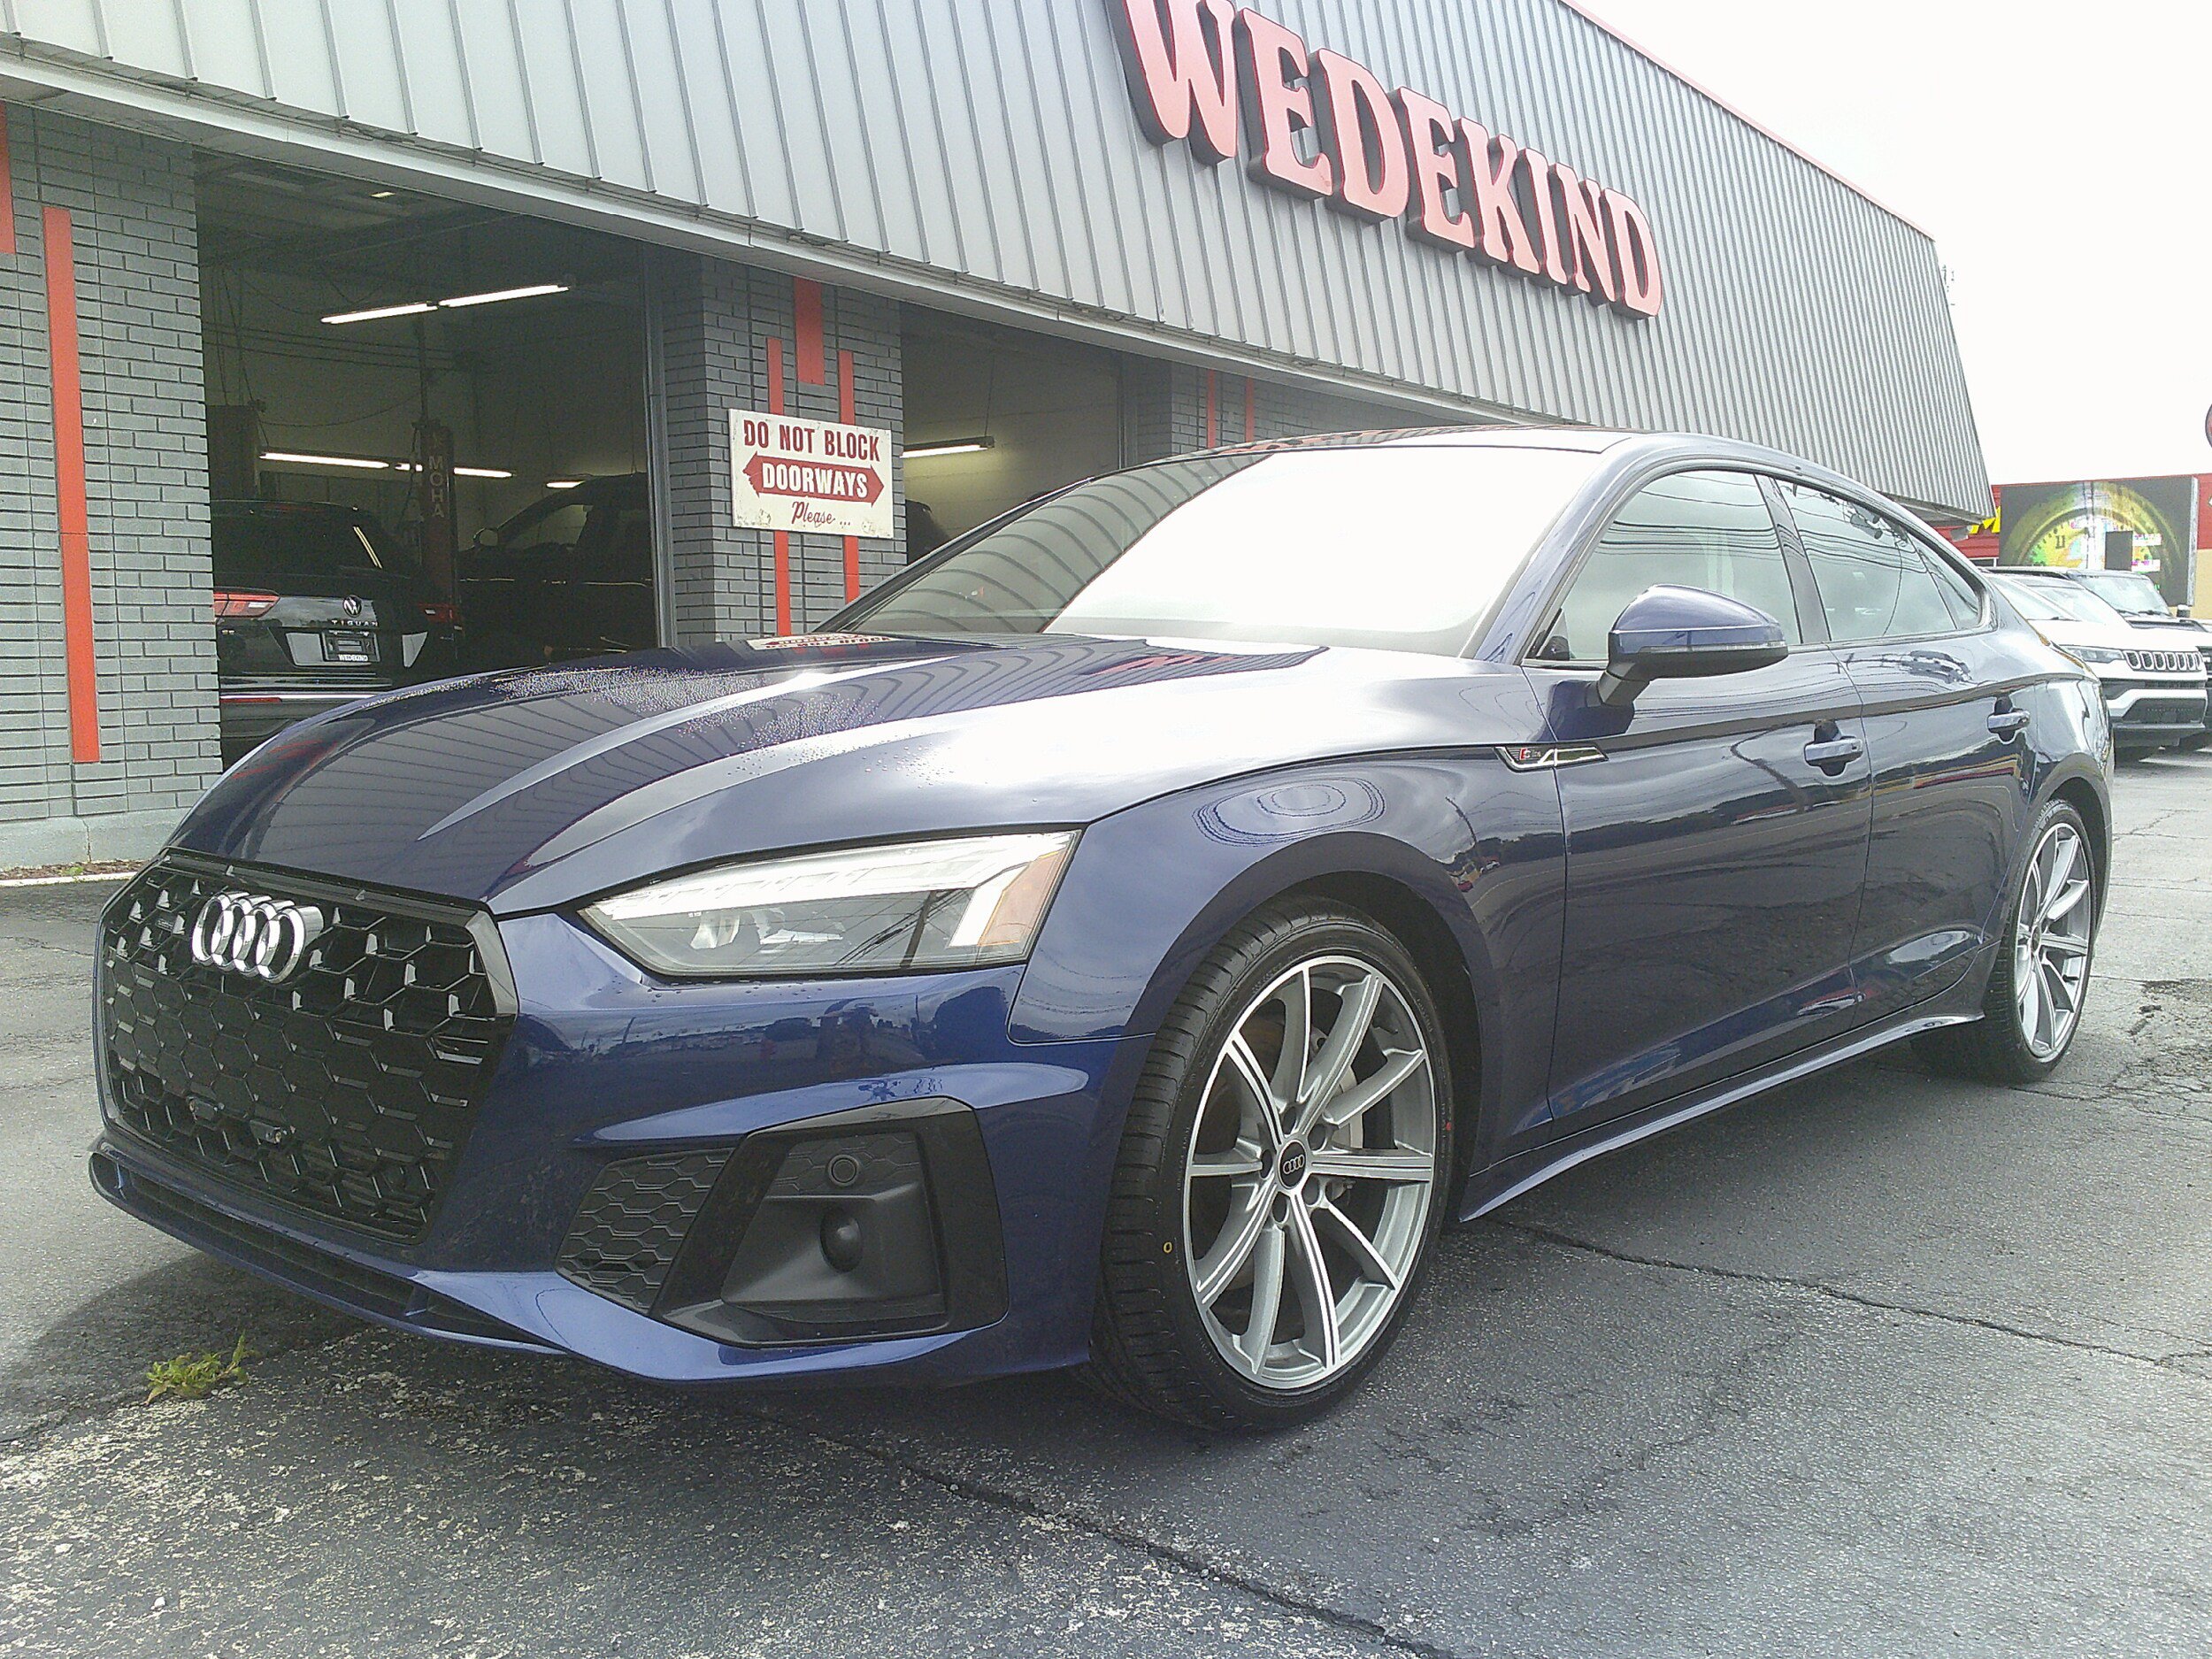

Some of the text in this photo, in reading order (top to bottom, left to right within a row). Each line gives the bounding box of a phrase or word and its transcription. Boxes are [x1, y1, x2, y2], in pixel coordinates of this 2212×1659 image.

[1120, 0, 1663, 319] WEDEKIND
[743, 419, 880, 462] DO NOT BLOCK
[762, 462, 869, 499] DOORWAYS
[791, 501, 835, 526] Please
